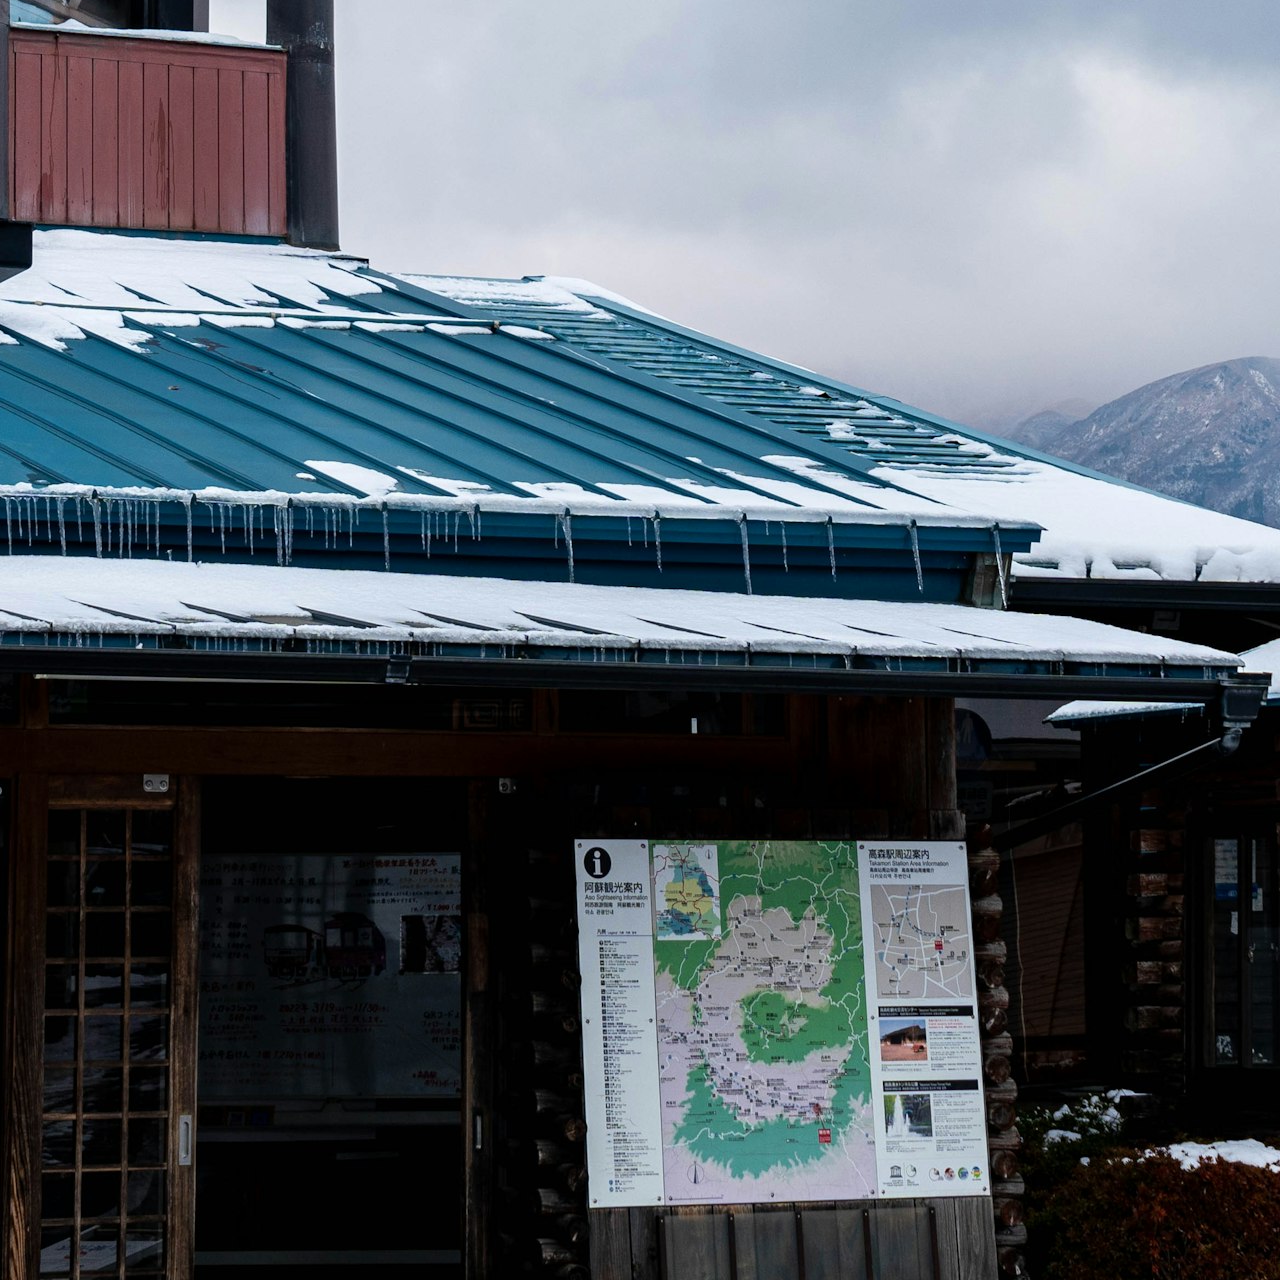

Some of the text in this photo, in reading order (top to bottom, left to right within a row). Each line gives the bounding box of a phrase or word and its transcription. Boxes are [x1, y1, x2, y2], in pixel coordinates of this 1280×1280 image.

[584, 882, 643, 893] 阿蘇観光案内
